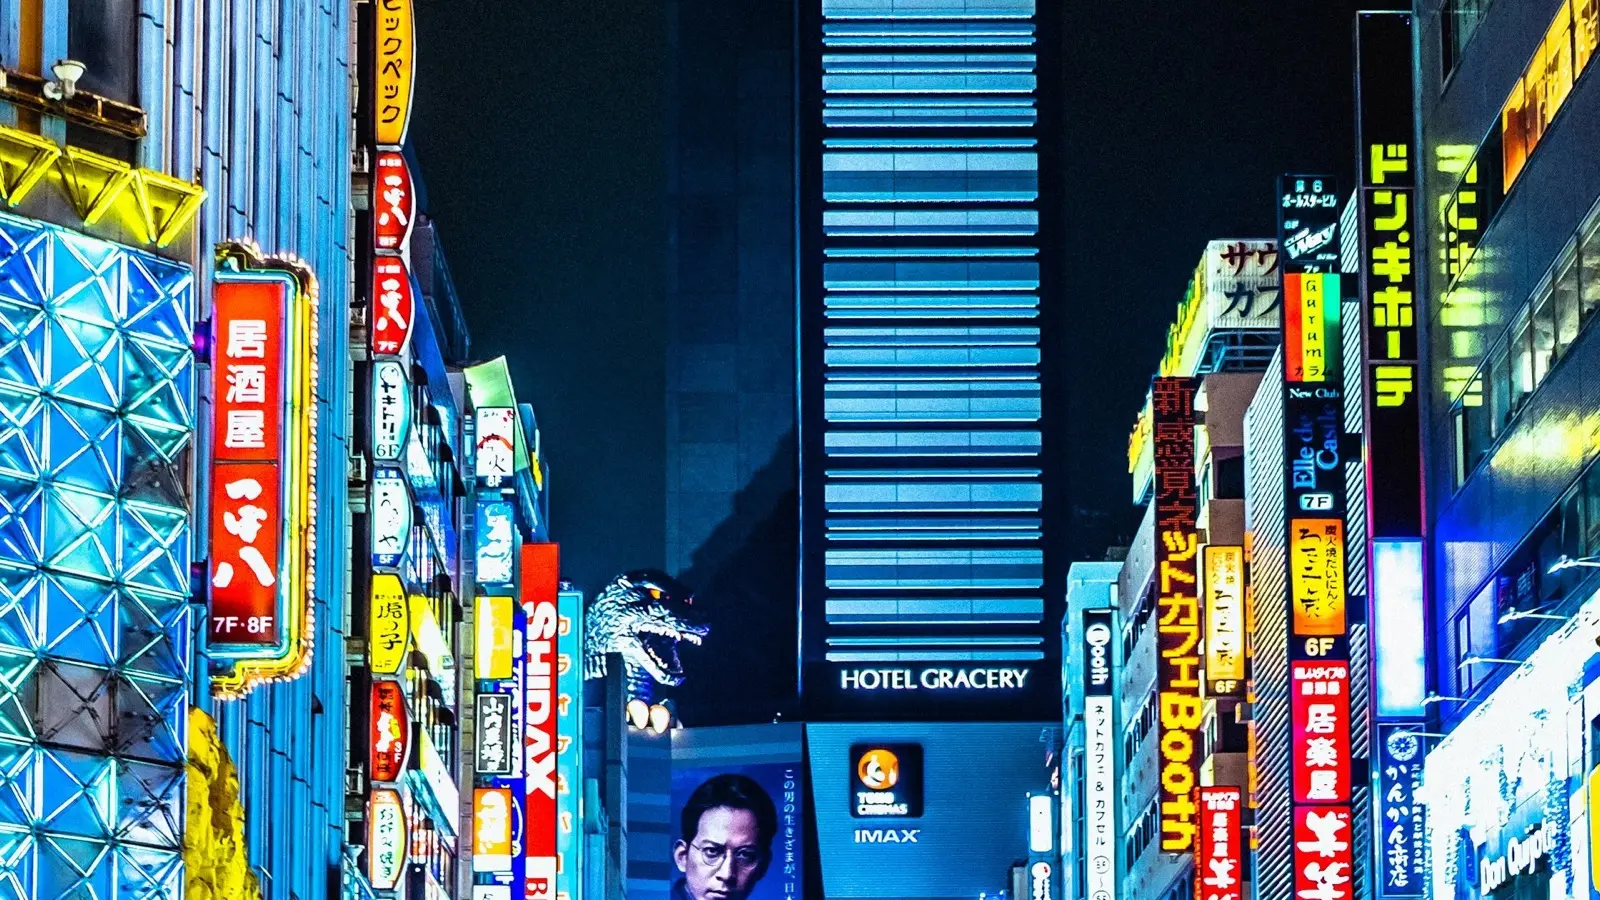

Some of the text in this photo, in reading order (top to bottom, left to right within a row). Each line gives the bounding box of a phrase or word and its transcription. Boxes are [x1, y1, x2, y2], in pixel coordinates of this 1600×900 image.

[1370, 144, 1412, 406] ドン・キホーテ
[1289, 388, 1312, 398] New
[212, 320, 276, 589] 居酒屋 つぼ八
[376, 444, 400, 457] 6F
[1293, 446, 1316, 489] Elle
[1304, 496, 1329, 508] 7F
[1305, 637, 1335, 656] 6F
[840, 668, 1029, 690] HOTEL GRACERY
[1215, 680, 1237, 693] 6F
[523, 601, 557, 800] SHIDAX
[854, 829, 919, 843] IMAX
[1386, 764, 1409, 887] かんかん商店
[1480, 856, 1506, 896] Don
[525, 877, 548, 900] B
